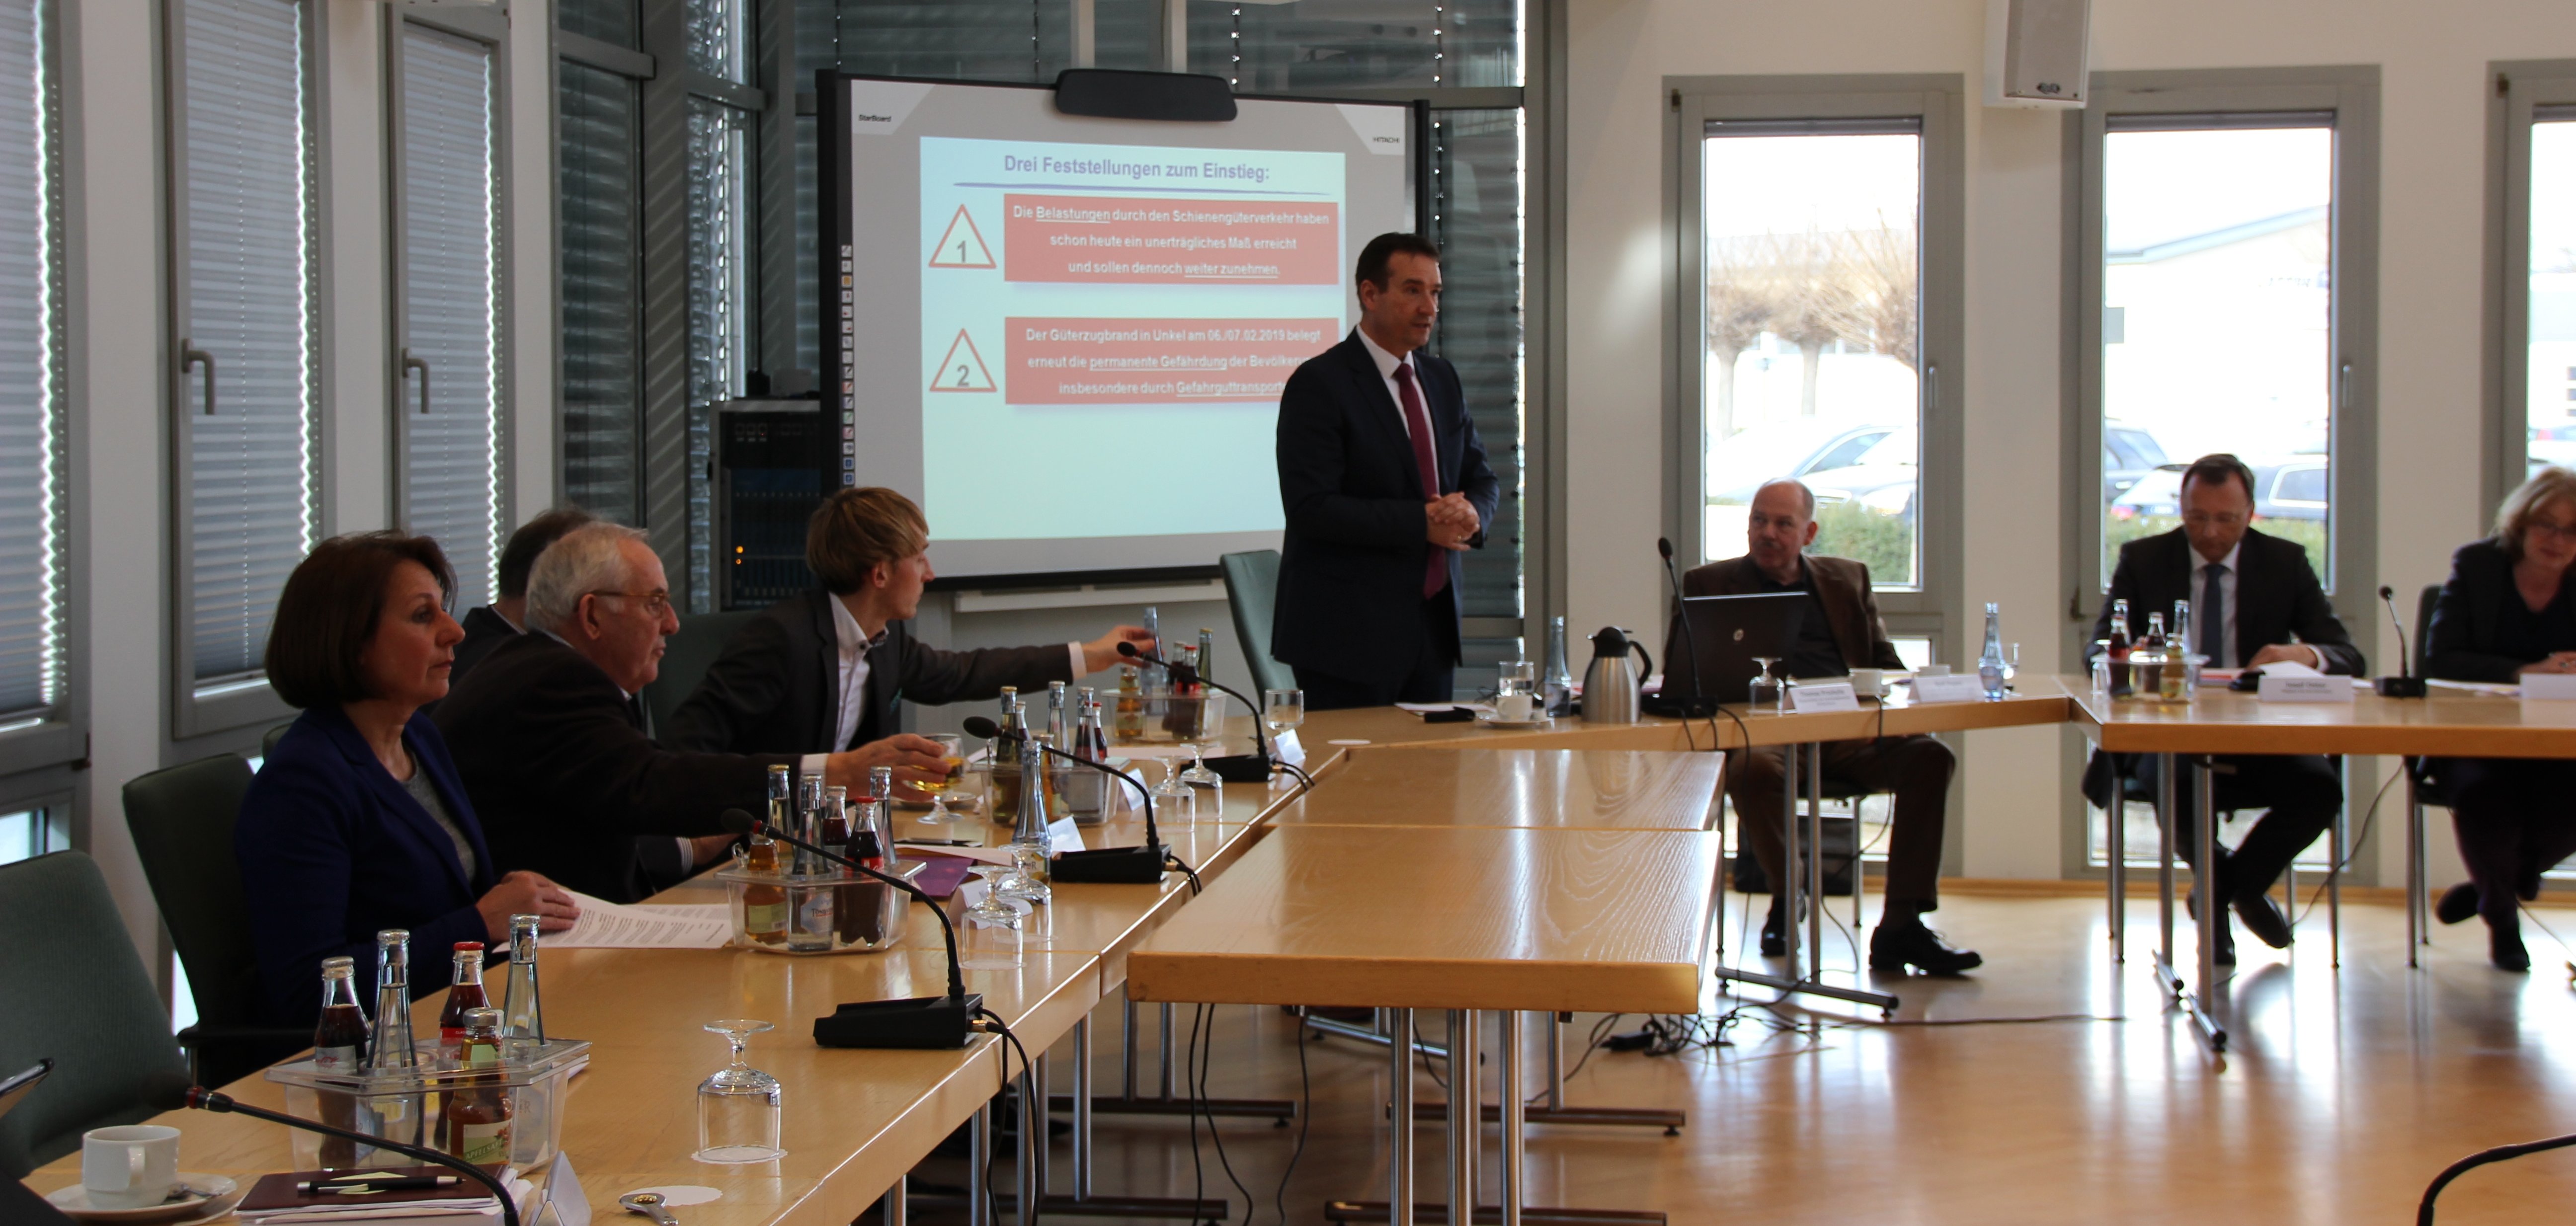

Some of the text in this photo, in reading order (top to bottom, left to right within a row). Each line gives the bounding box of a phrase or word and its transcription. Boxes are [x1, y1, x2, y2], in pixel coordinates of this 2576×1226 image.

[1004, 154, 1270, 183] Drei Feststellungen zum Einstieg:
[1013, 205, 1330, 225] Die Belastungen durch den Schienengüterverkehr haben
[1049, 234, 1297, 251] schon heute ein unerträgliches Maß erreicht
[957, 240, 966, 263] 1
[1068, 260, 1281, 275] und sollen dennoch weiter zunehmen.
[1026, 328, 1321, 344] Der Güterzugbrand in Unkel am 06./07.02.2019 belegt
[1027, 356, 1067, 368] erneut
[1069, 355, 1087, 368] die
[1090, 356, 1158, 371] permanente
[1229, 356, 1248, 367] der
[957, 365, 969, 387] 2
[1058, 382, 1138, 394] insbesondere
[1140, 382, 1174, 394] durch
